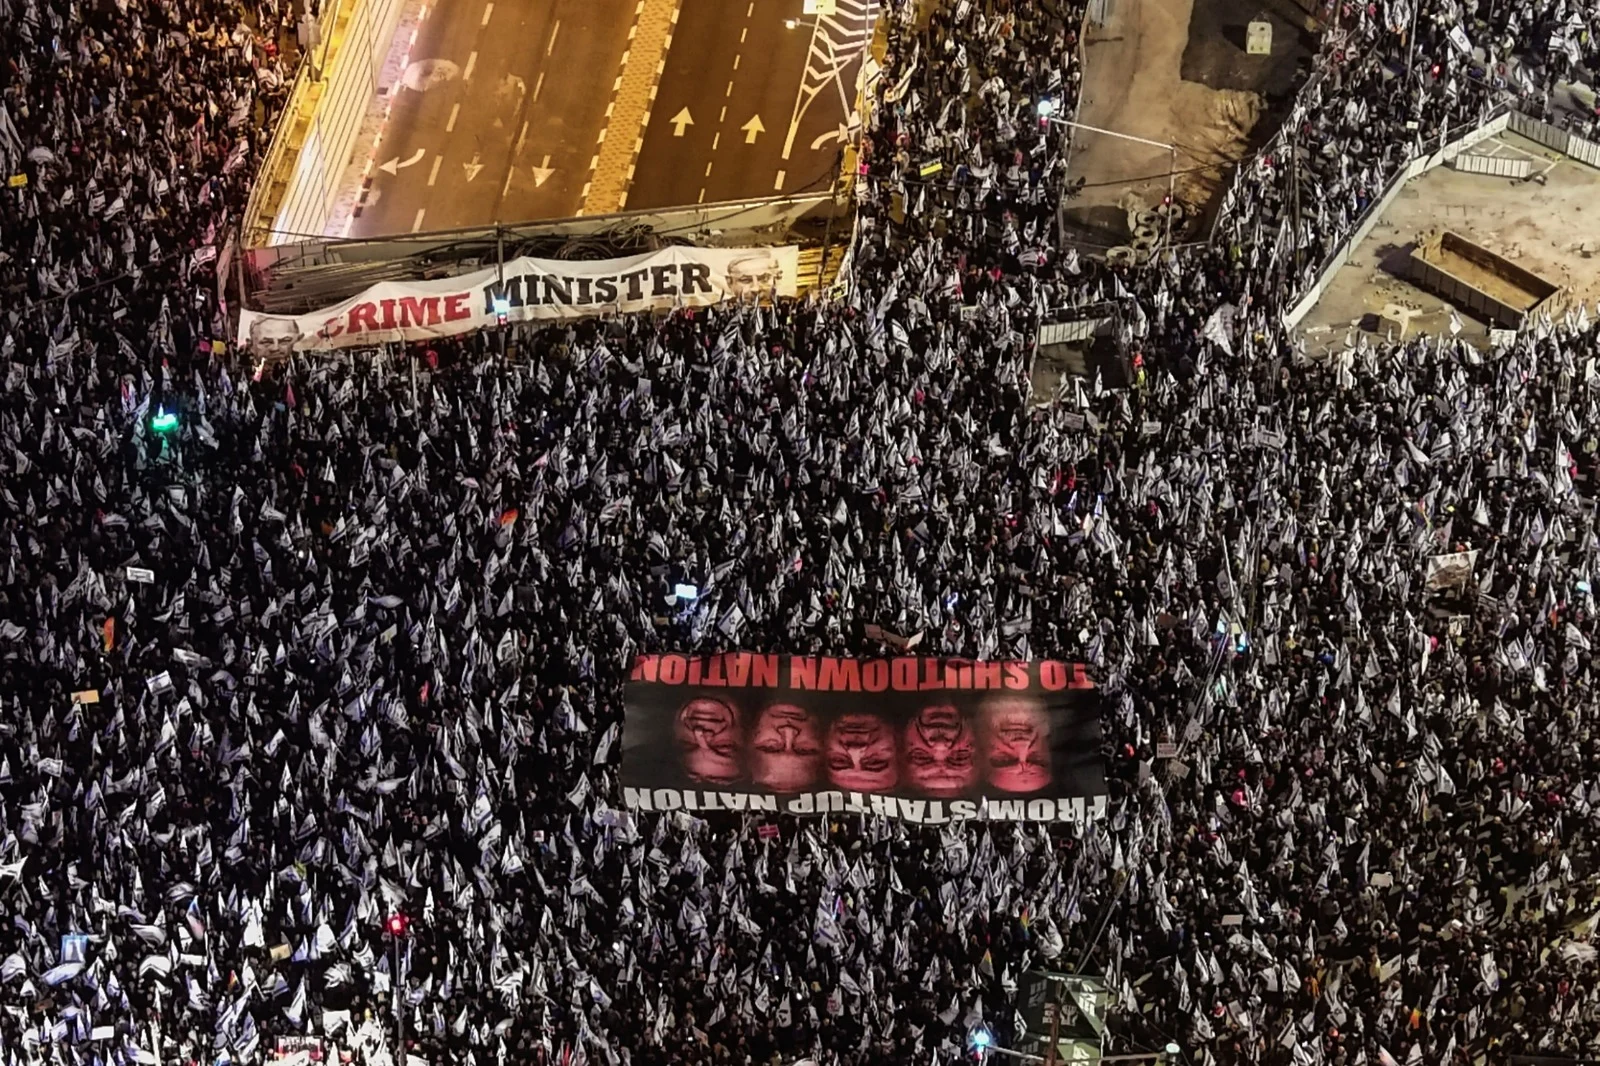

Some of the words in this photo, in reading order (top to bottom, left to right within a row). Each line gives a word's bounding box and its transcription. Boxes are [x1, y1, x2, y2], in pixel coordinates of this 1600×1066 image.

[317, 291, 471, 339] CRIME
[483, 263, 712, 315] MINISTER
[631, 653, 779, 687] NATION
[789, 656, 1029, 692] SHUTDOWN
[1040, 660, 1095, 689] TO
[624, 787, 777, 812] NATION
[789, 791, 978, 824] STARTUP
[987, 796, 1107, 822] FROM
